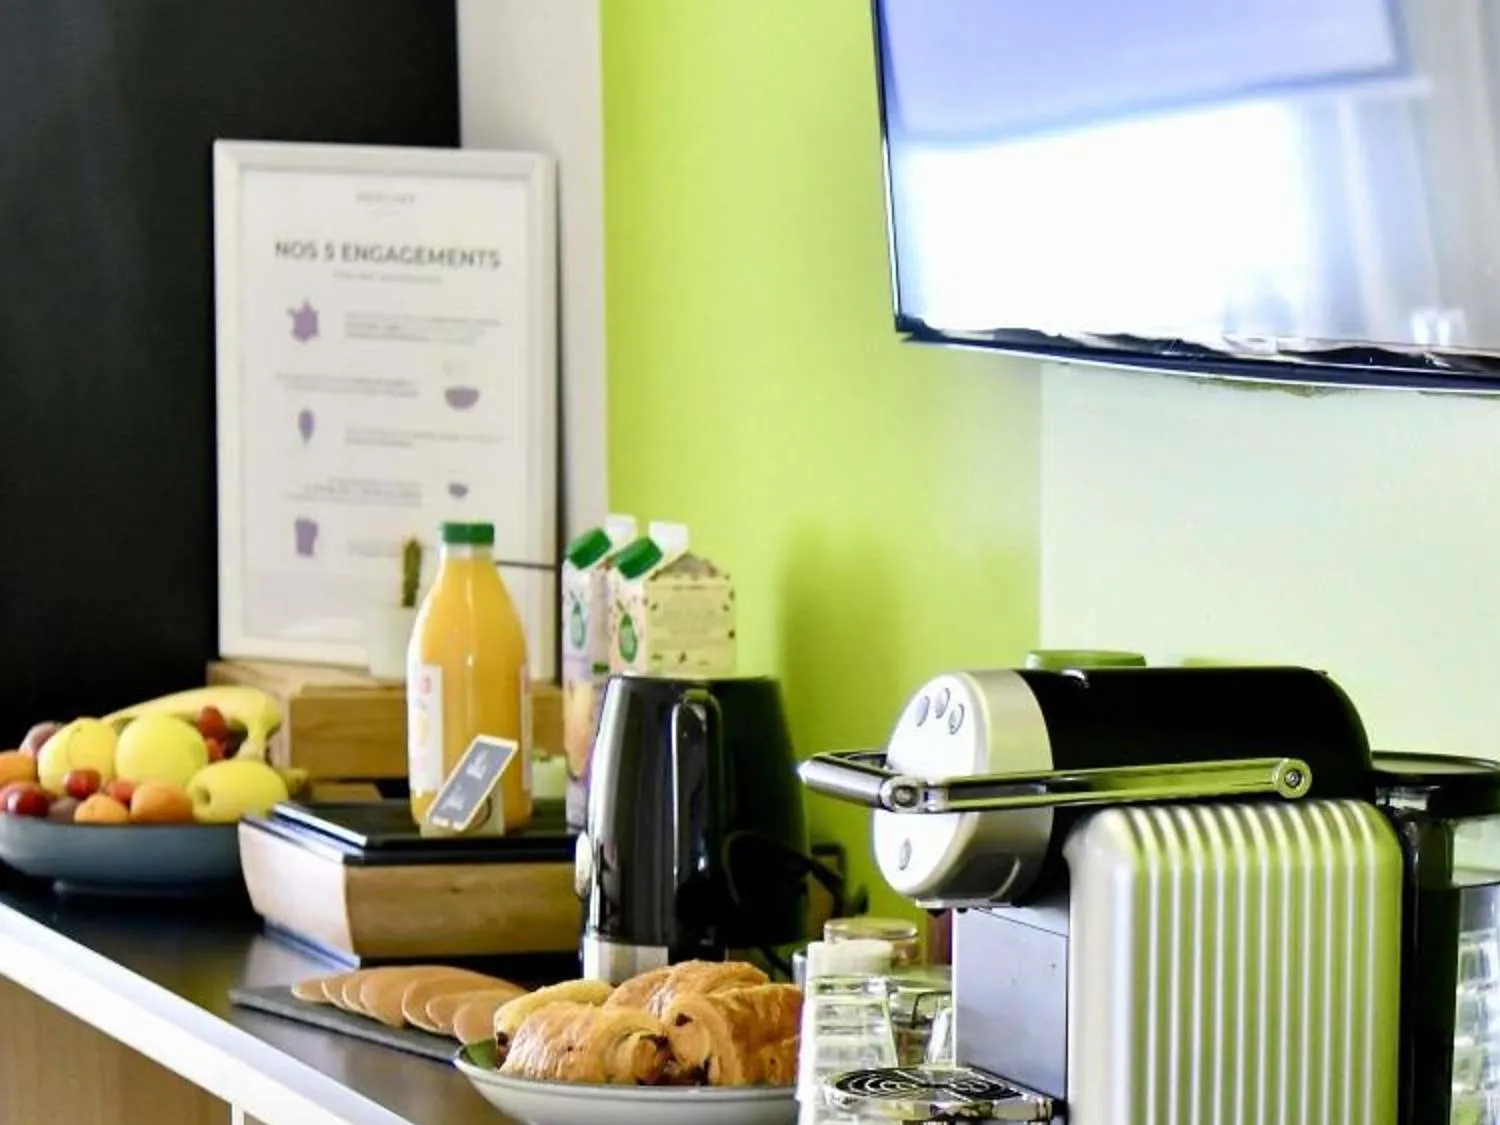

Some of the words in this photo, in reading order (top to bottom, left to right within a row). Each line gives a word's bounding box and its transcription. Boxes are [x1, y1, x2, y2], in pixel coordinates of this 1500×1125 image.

[274, 241, 318, 261] NOS
[323, 242, 336, 263] 5
[340, 243, 502, 270] ENGAGEMENTS
